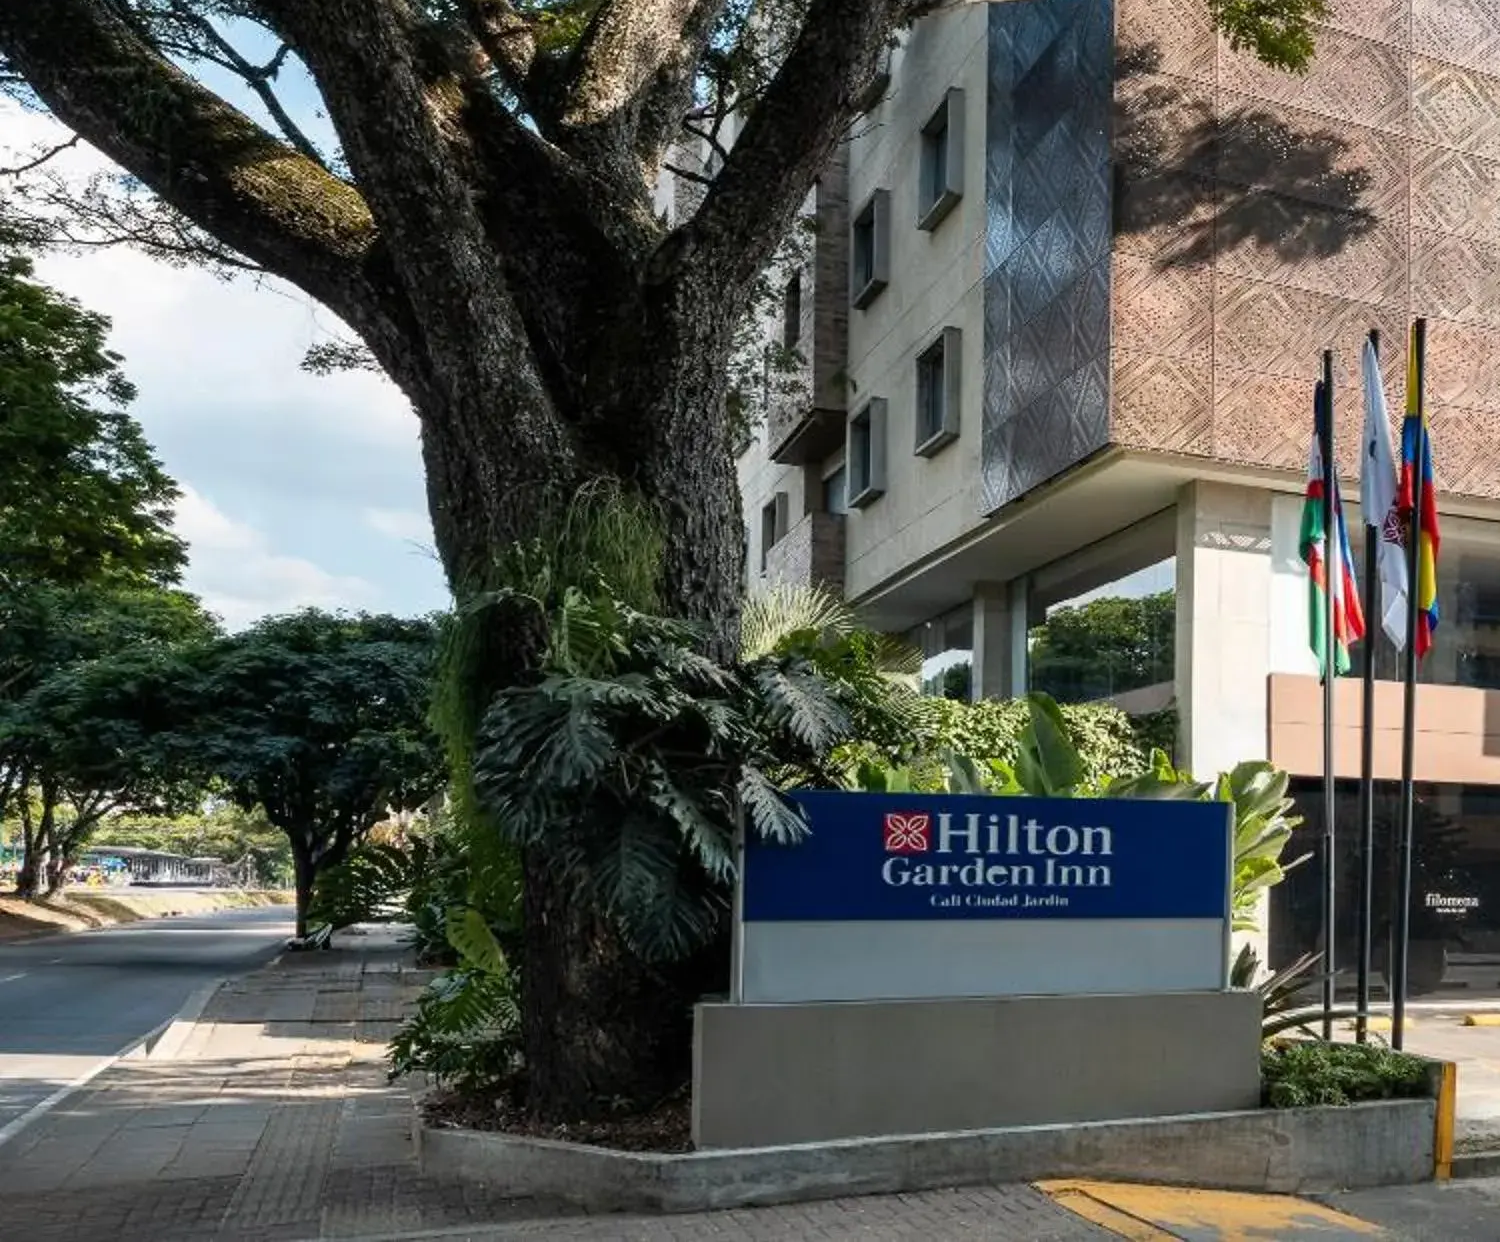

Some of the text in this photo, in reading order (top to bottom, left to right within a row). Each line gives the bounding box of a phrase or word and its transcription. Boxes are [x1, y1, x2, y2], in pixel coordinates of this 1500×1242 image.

[936, 813, 1113, 855] Hilton
[882, 857, 1112, 886] Garden Inn
[929, 893, 962, 907] Cali
[965, 893, 1019, 907] Ciudad
